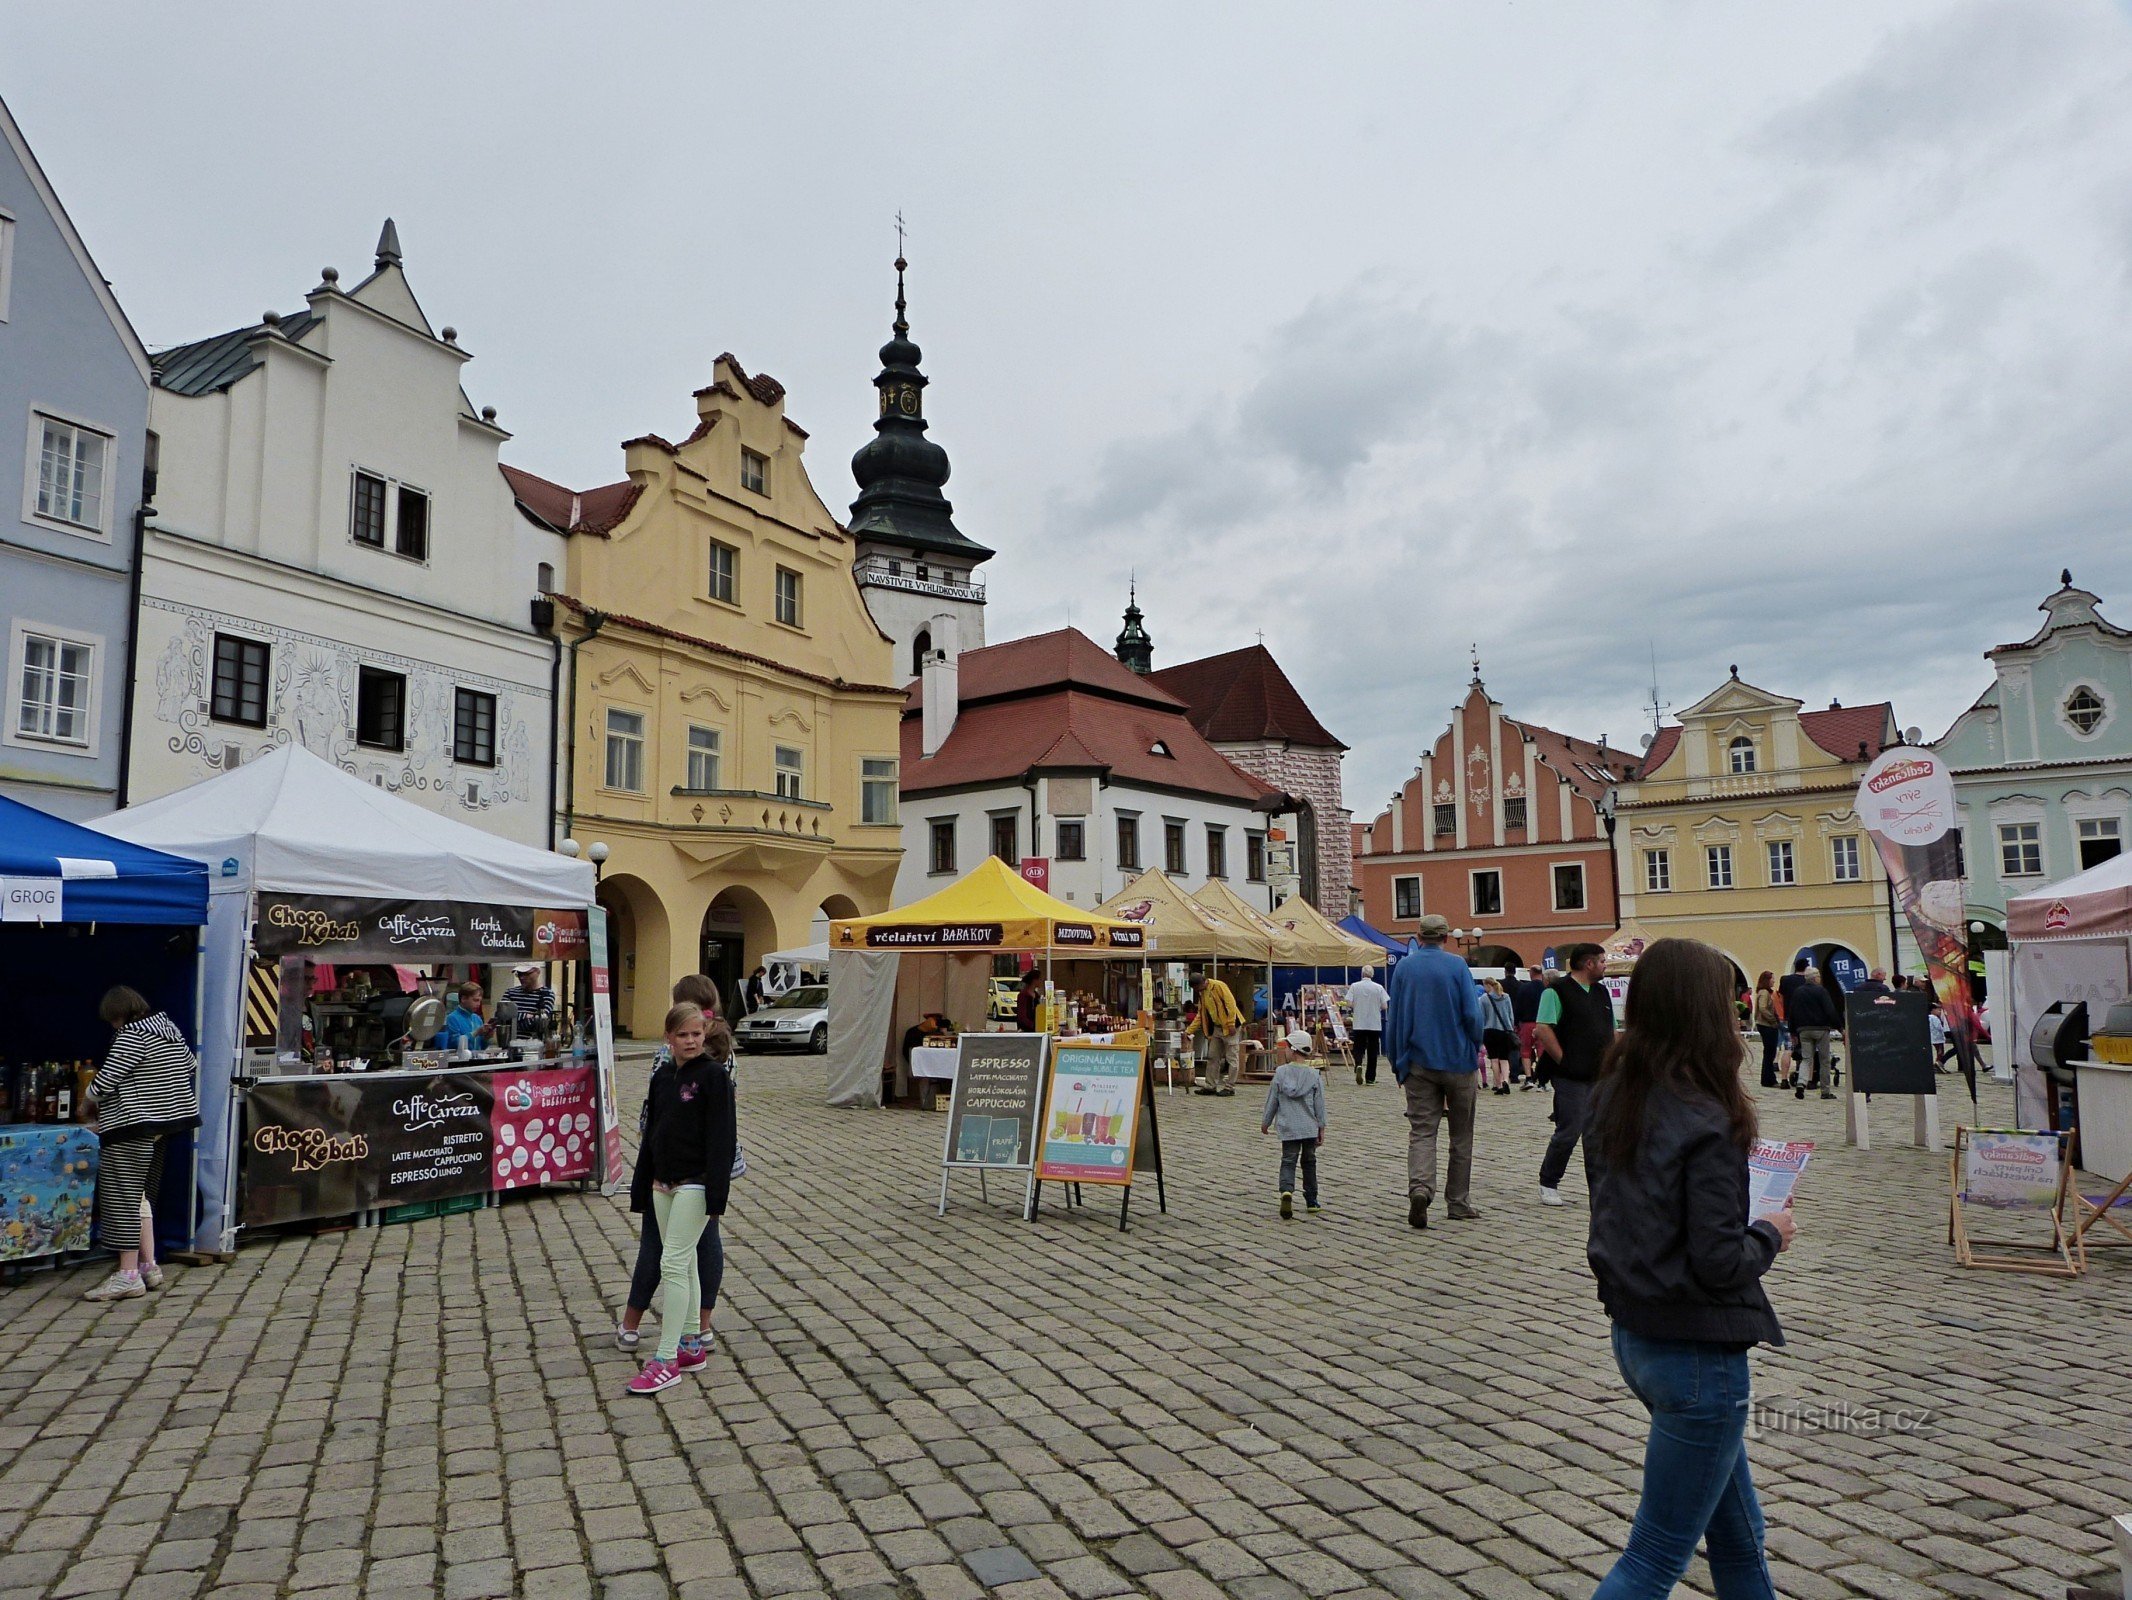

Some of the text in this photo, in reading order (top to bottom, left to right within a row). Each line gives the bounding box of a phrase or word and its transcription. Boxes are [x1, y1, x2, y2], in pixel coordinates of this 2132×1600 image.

[10, 889, 55, 904] GROG
[268, 904, 327, 927] Choco
[378, 914, 456, 937] Caffe Carezza
[470, 916, 502, 932] Horká
[298, 920, 360, 945] Kebab
[481, 931, 526, 949] Čokoláda
[874, 931, 937, 942] včelařství
[1058, 928, 1093, 939] MEDOVINA
[971, 1058, 1031, 1069] ESPRESSO
[1062, 1052, 1115, 1065] ORIGINÁLNÍ
[1093, 1065, 1118, 1073] BUBBLE
[968, 1085, 992, 1095] HORKÁ
[392, 1094, 480, 1121] Caffe Carezza
[966, 1098, 1026, 1109] CAPPUCCINO
[254, 1125, 327, 1154] Choco
[443, 1132, 484, 1145] RISTRETTO
[291, 1134, 369, 1172] Kebab
[392, 1146, 453, 1162] LATTE MACCHIATO
[434, 1152, 483, 1167] CAPPUCCINO
[390, 1166, 463, 1185] ESPRESSO LUNGO
